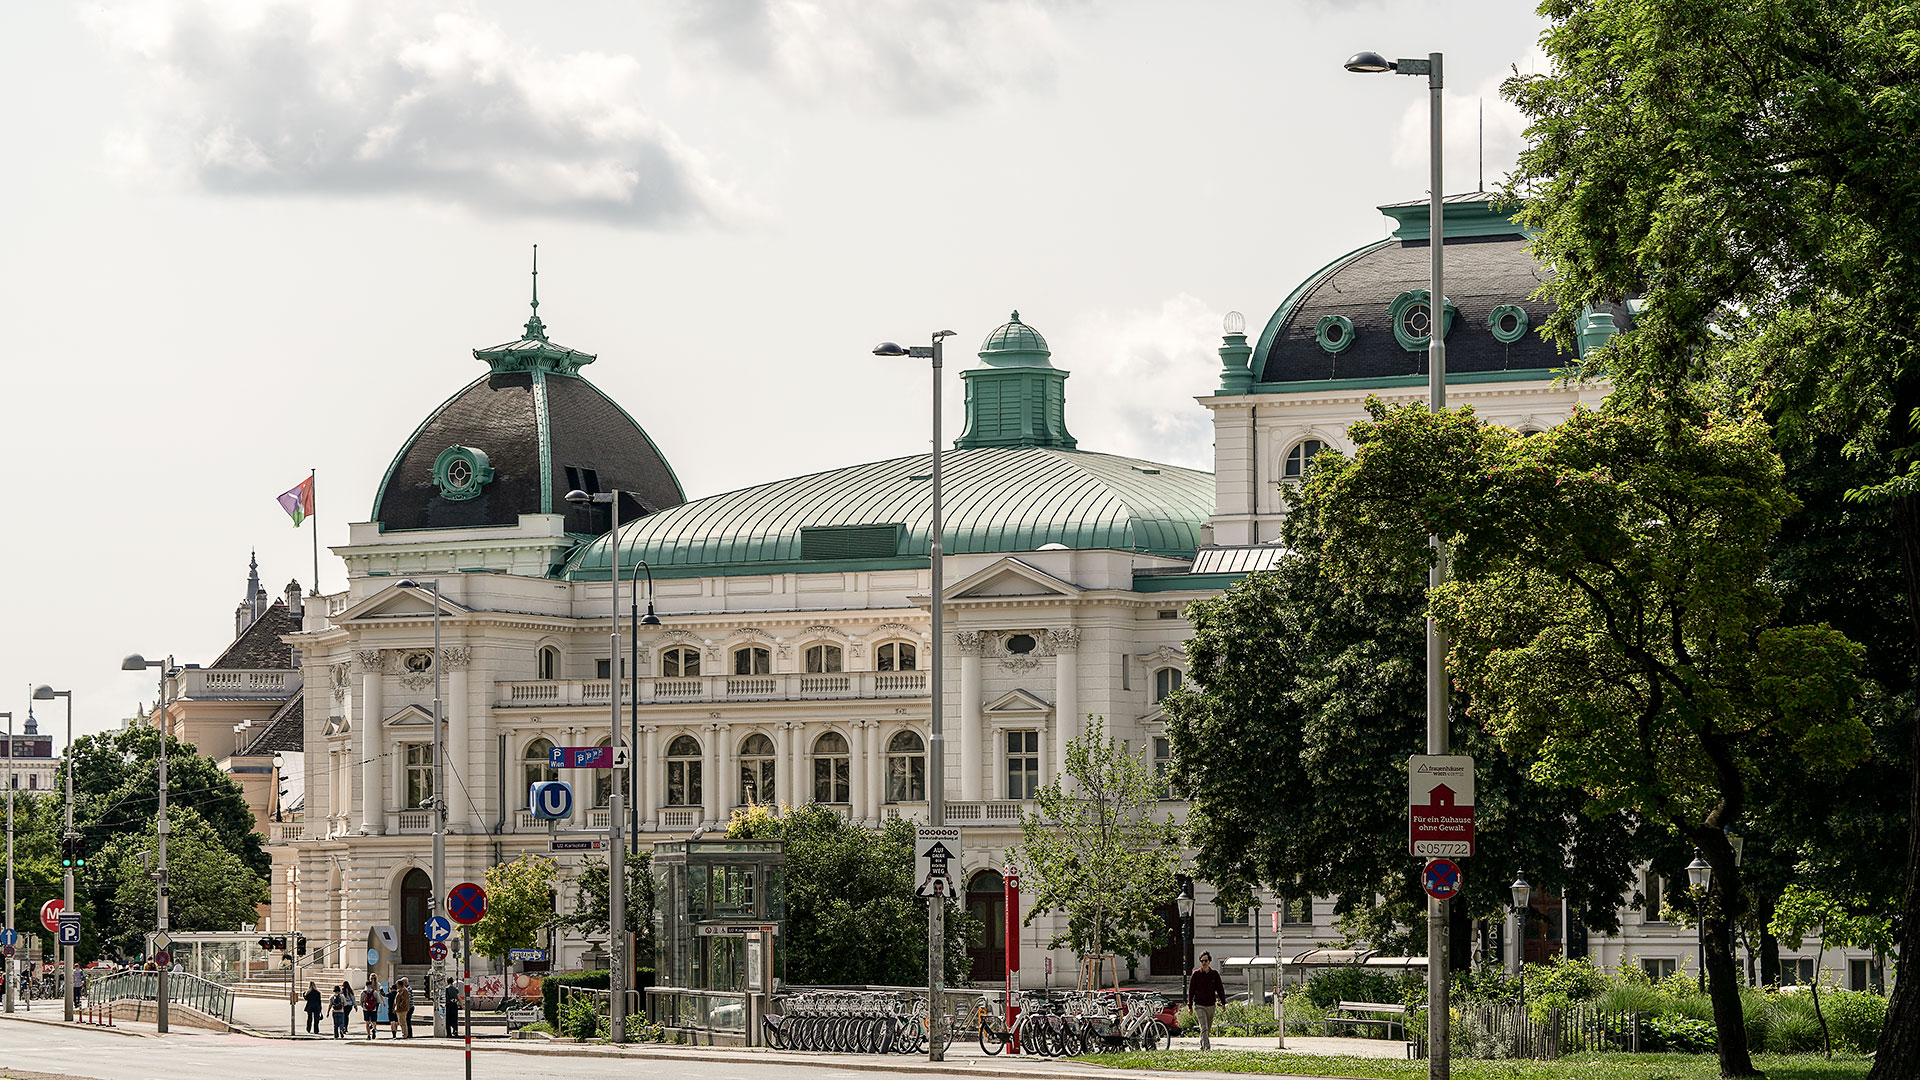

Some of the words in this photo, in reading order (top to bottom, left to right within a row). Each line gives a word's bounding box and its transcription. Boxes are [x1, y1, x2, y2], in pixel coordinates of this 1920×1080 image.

[544, 790, 567, 815] U
[1440, 816, 1472, 824] Zuhause
[1426, 844, 1468, 854] 057722
